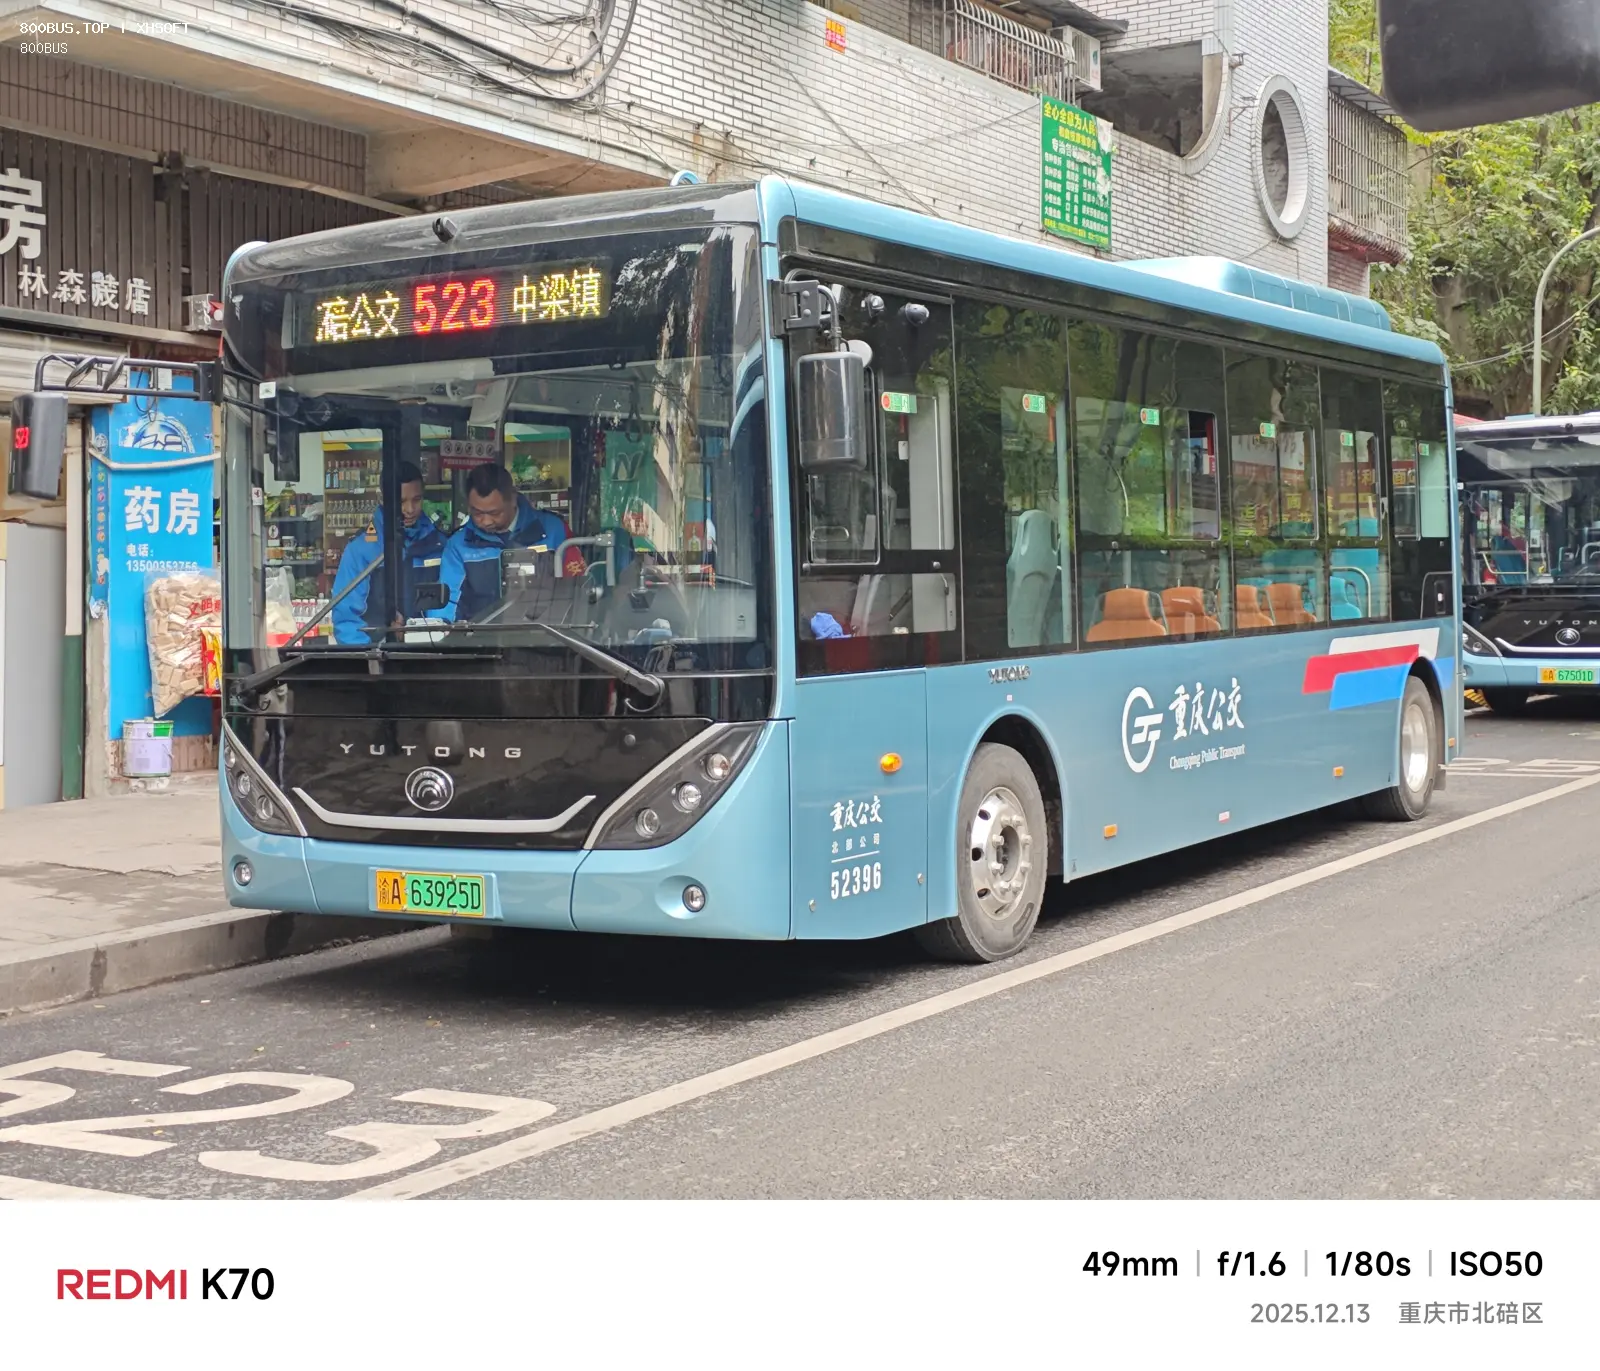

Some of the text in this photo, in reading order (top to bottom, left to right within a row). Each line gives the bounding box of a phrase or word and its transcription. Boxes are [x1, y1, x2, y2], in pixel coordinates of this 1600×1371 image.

[0, 168, 46, 260] 房
[413, 279, 496, 336] 523
[513, 267, 601, 324] 中梁镇
[124, 485, 201, 536] 药房
[1558, 670, 1593, 681] 67501D
[1168, 677, 1245, 741] 重庆公交
[339, 742, 523, 759] YUTONG
[1169, 744, 1246, 771] Chongqing Public Transport
[829, 795, 883, 832] 重庆公交
[379, 877, 482, 910] 渝A 63925D
[830, 861, 882, 900] 52396
